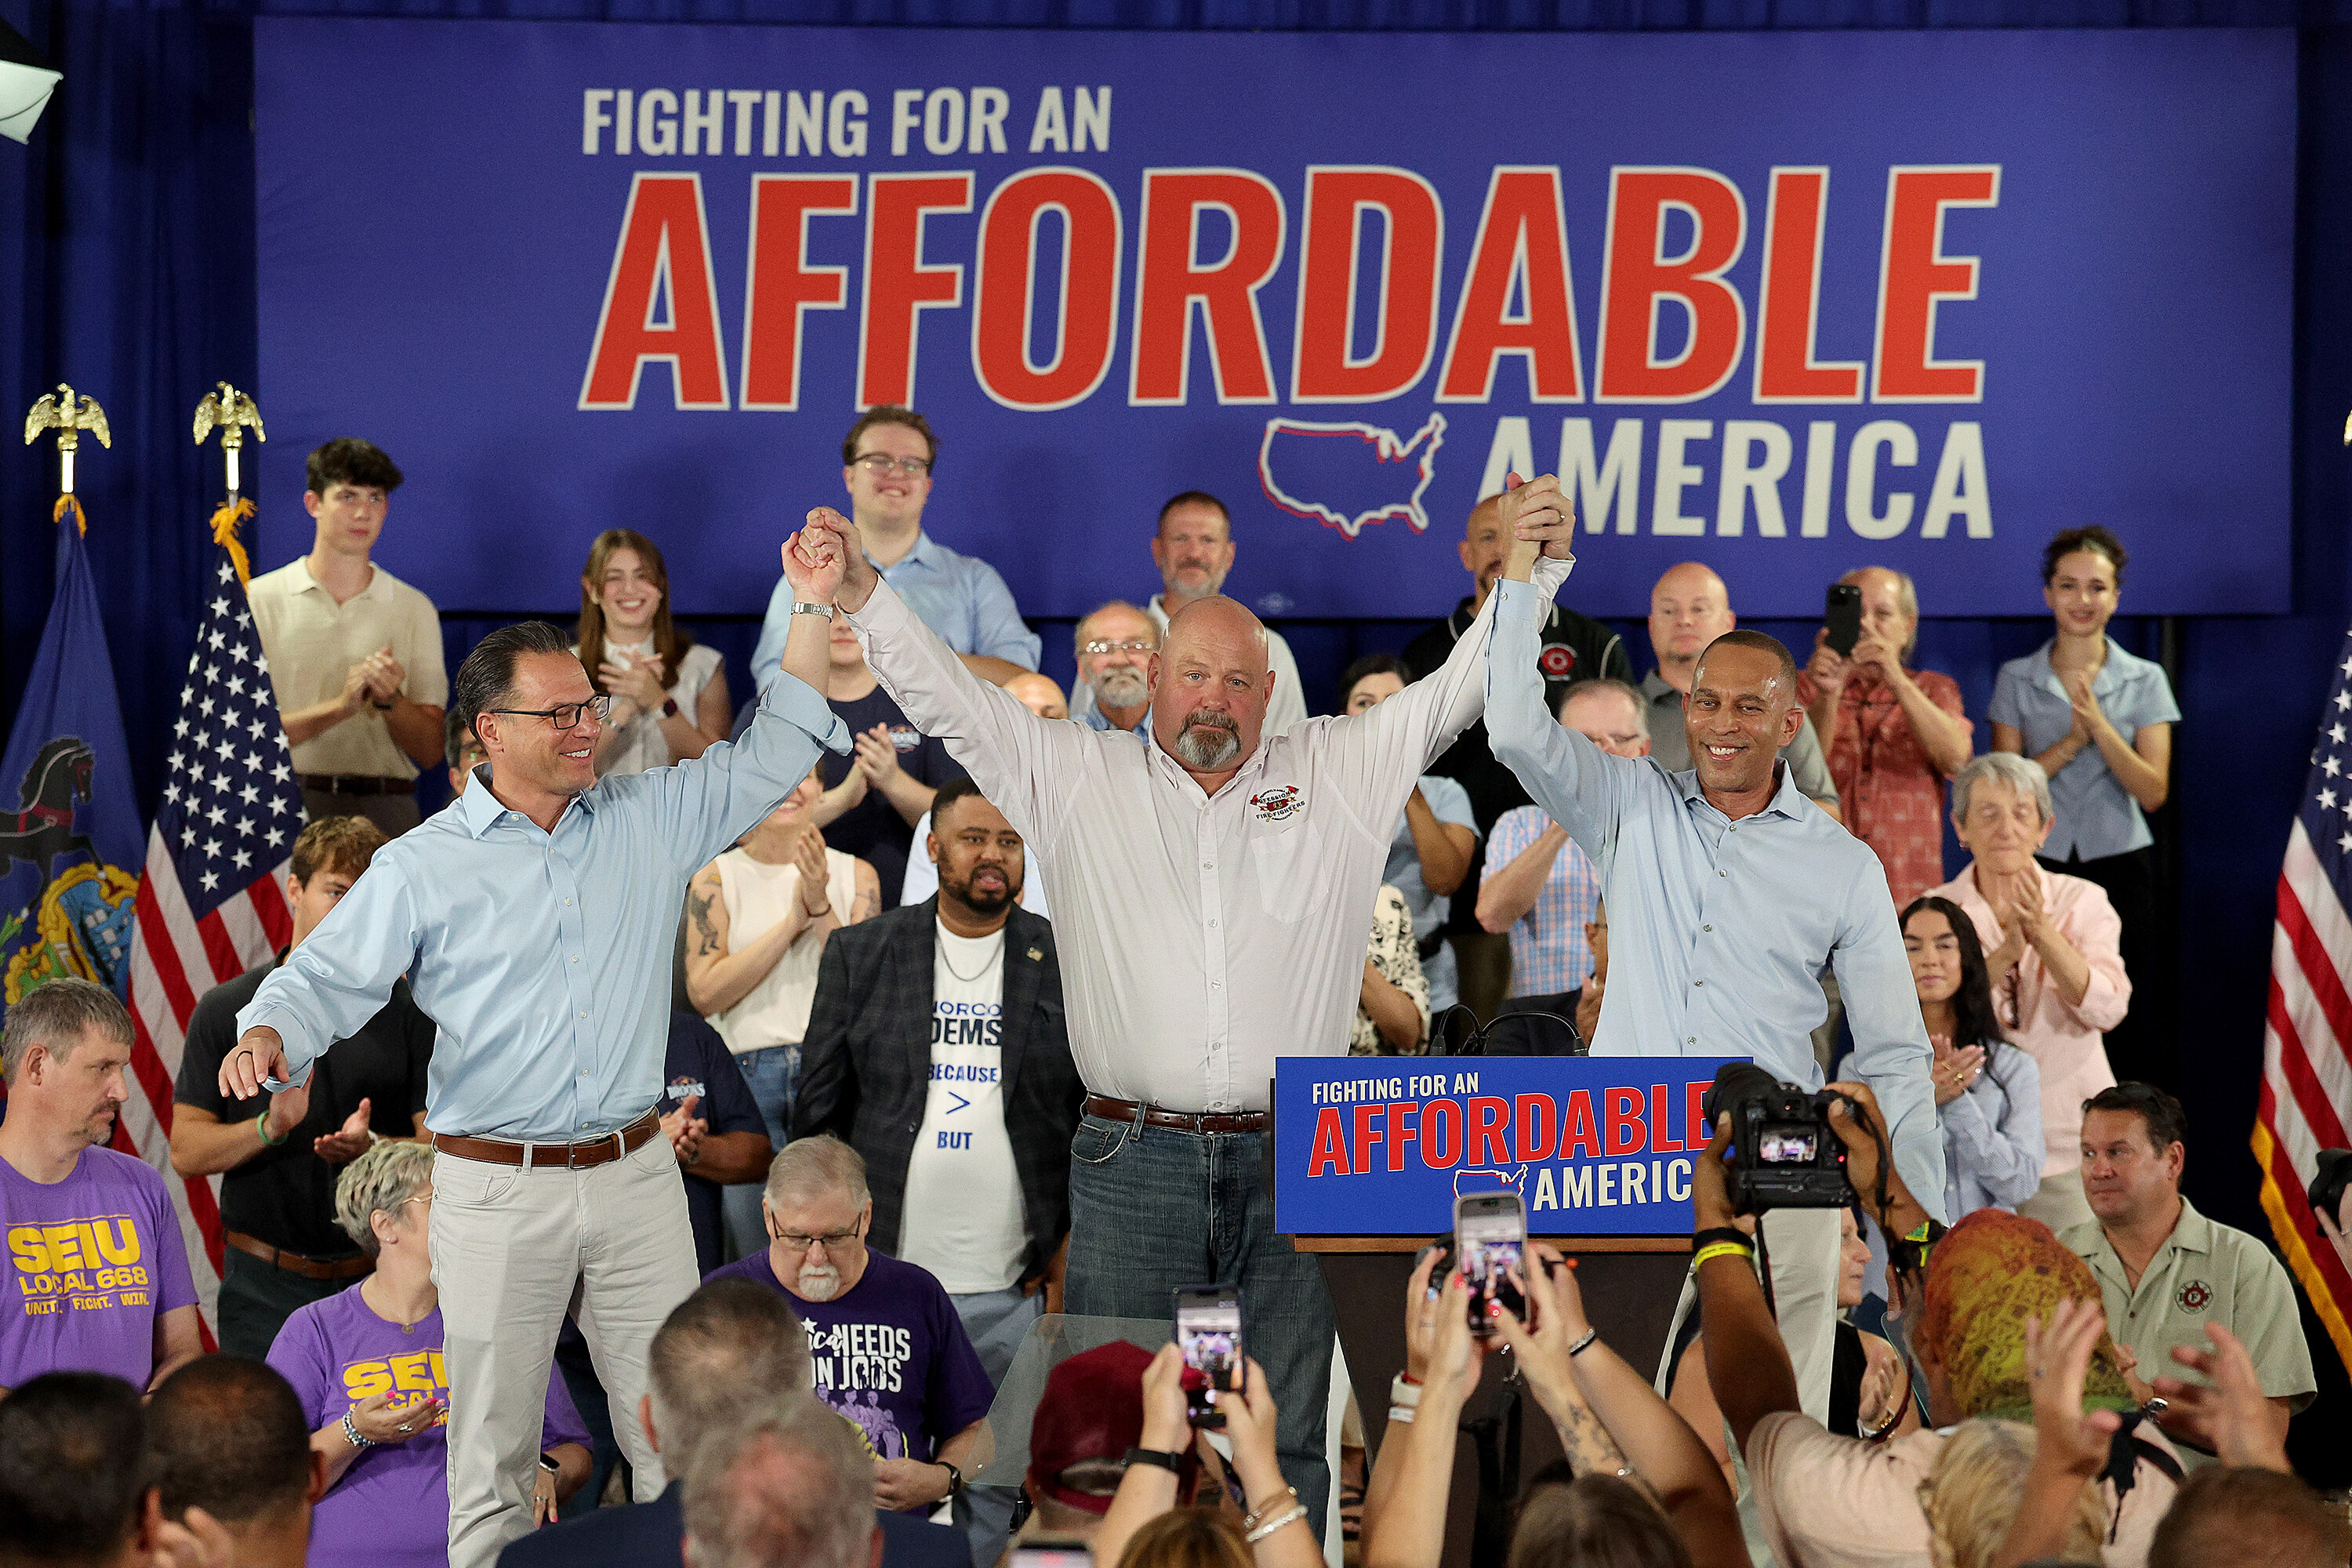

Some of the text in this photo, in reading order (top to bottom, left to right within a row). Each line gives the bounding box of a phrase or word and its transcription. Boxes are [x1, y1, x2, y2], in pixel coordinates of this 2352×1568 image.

[583, 85, 1112, 157] FIGHTING FOR AN
[576, 164, 2002, 413] AFFORDABLE
[1476, 415, 1993, 539] AMERICA
[1273, 800, 1305, 817] FIGHTERS
[928, 1063, 998, 1083] BECAUSE
[1312, 1072, 1479, 1105] FIGHTING FOR AN
[937, 1131, 973, 1150] BUT
[1307, 1080, 1715, 1178] AFFORDABLE
[1533, 1158, 1693, 1211] AMERIC
[7, 1219, 141, 1273] SEIU
[18, 1265, 149, 1295] LOCAL 668
[24, 1300, 64, 1316] UNIT.
[119, 1292, 150, 1306] WIN.
[832, 1323, 911, 1362] NEEDS
[343, 1352, 450, 1400] SEI
